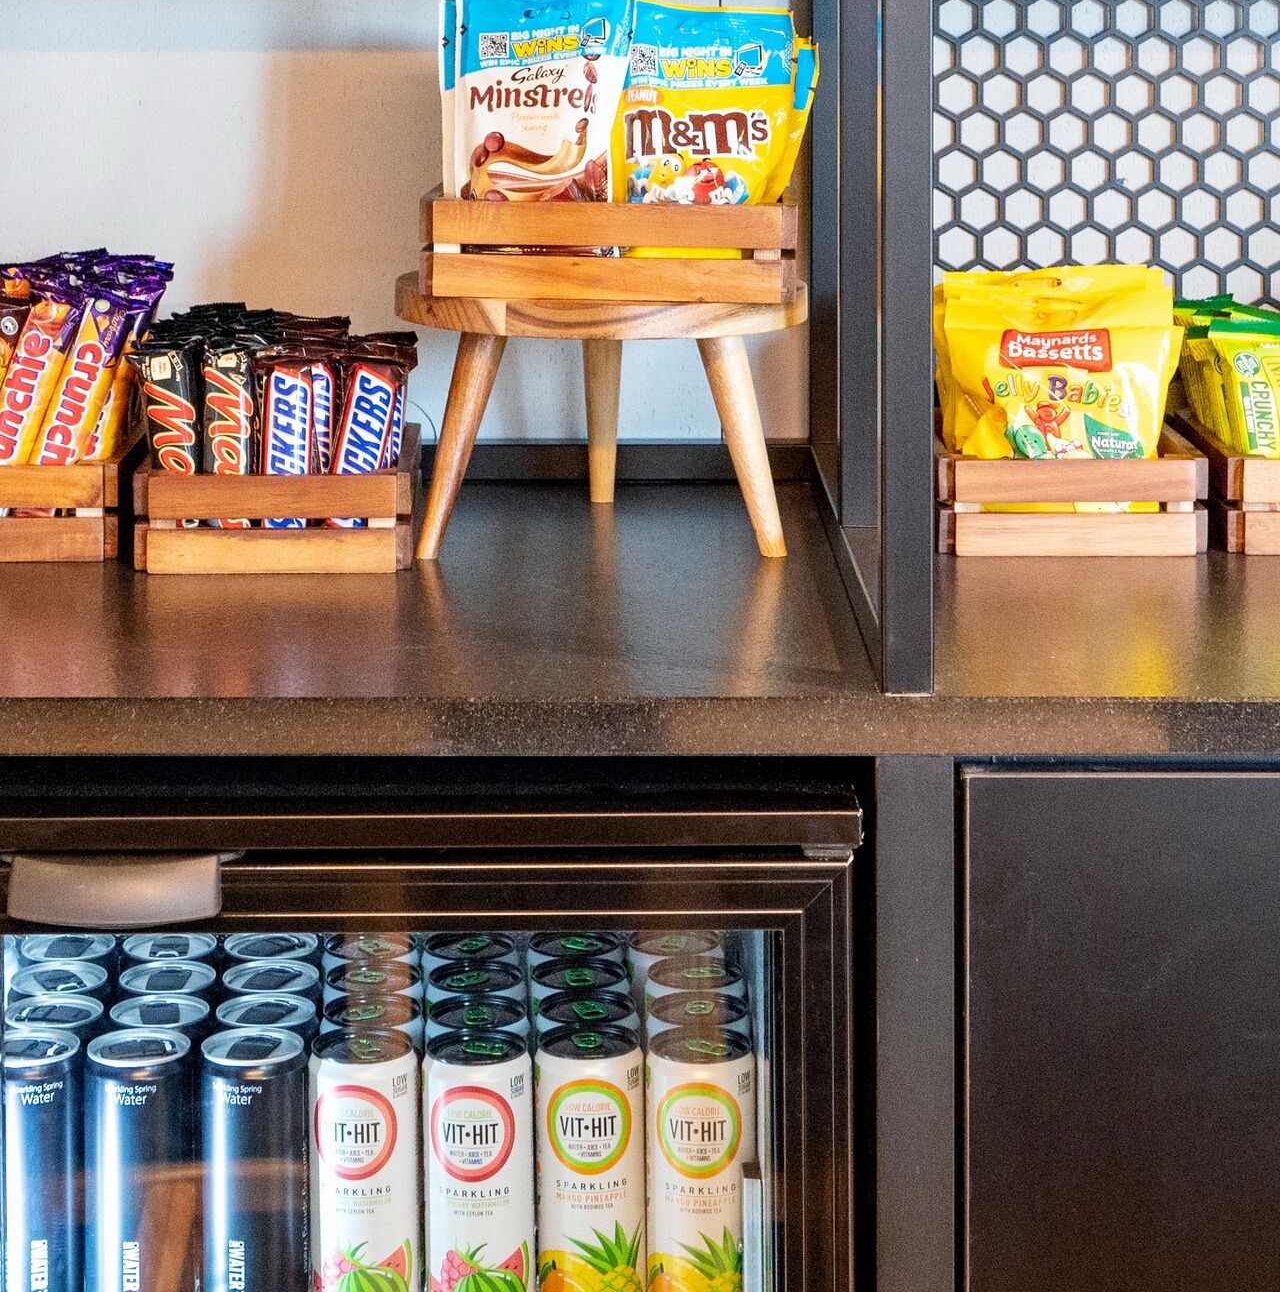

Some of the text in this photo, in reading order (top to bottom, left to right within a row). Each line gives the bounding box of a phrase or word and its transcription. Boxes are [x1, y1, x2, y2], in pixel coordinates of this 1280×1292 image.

[511, 25, 580, 41] BIG NIGHT IN
[660, 46, 733, 58] BIG NIGHT IN
[510, 65, 566, 85] Galaxy
[470, 81, 597, 114] Minstrels
[627, 88, 659, 104] PEANUT
[1016, 333, 1097, 348] Maynards
[1008, 343, 1104, 362] Bassetts
[982, 374, 1133, 418] Jelly Babies
[40, 343, 103, 466] crunch
[203, 366, 254, 475] Ma
[1251, 380, 1278, 451] CRUNCHY
[510, 1073, 524, 1088] LOW
[627, 1068, 639, 1079] LOW
[42, 1080, 63, 1094] Spring
[136, 1084, 157, 1098] Spring
[20, 1091, 55, 1106] Water
[556, 1178, 627, 1191] SPARKLING
[665, 1182, 737, 1195] SPARKLING
